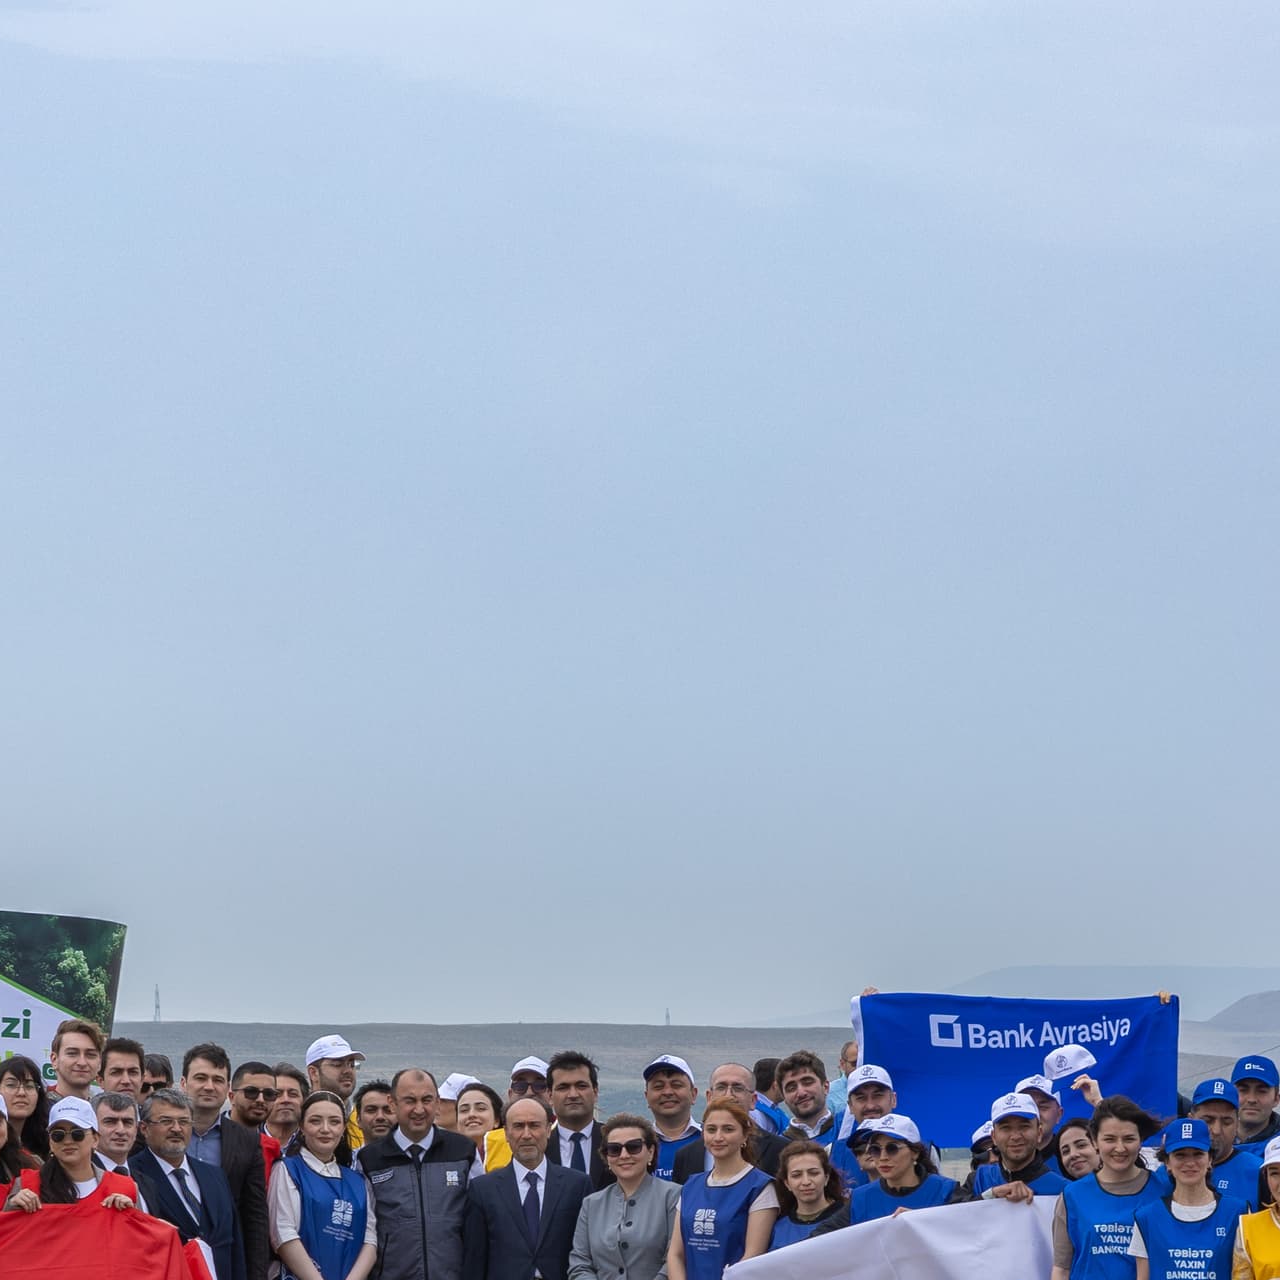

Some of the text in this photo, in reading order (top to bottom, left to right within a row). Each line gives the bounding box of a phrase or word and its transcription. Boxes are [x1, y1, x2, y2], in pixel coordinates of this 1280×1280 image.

[967, 1015, 1131, 1049] Bank Avrasiya
[1174, 1259, 1206, 1270] YAXIN
